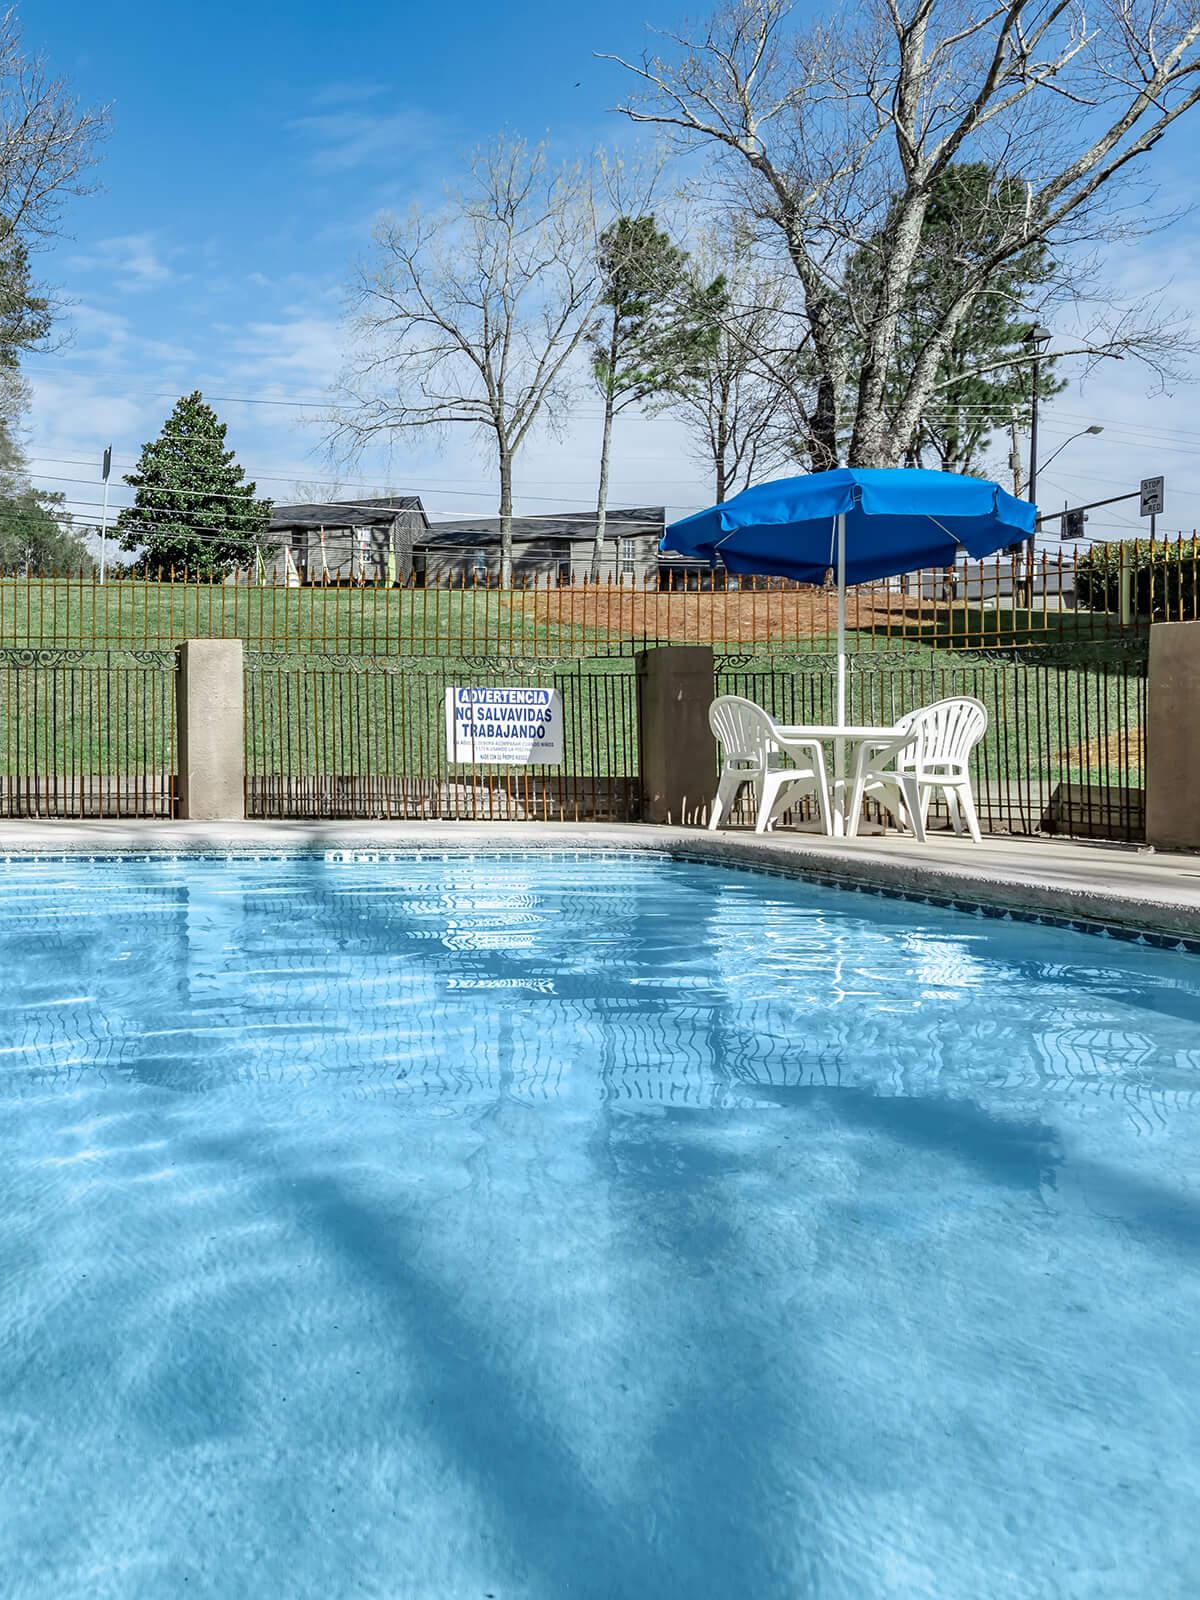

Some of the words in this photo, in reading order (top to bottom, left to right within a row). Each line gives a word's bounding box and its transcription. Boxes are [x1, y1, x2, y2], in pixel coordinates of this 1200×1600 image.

[1143, 480, 1161, 490] STOP
[1148, 503, 1161, 512] RED
[461, 688, 547, 704] ADVERTENCIA
[455, 706, 472, 721] NO
[477, 707, 552, 722] SALVAVIDAS
[461, 723, 546, 739] TRABAJANDO
